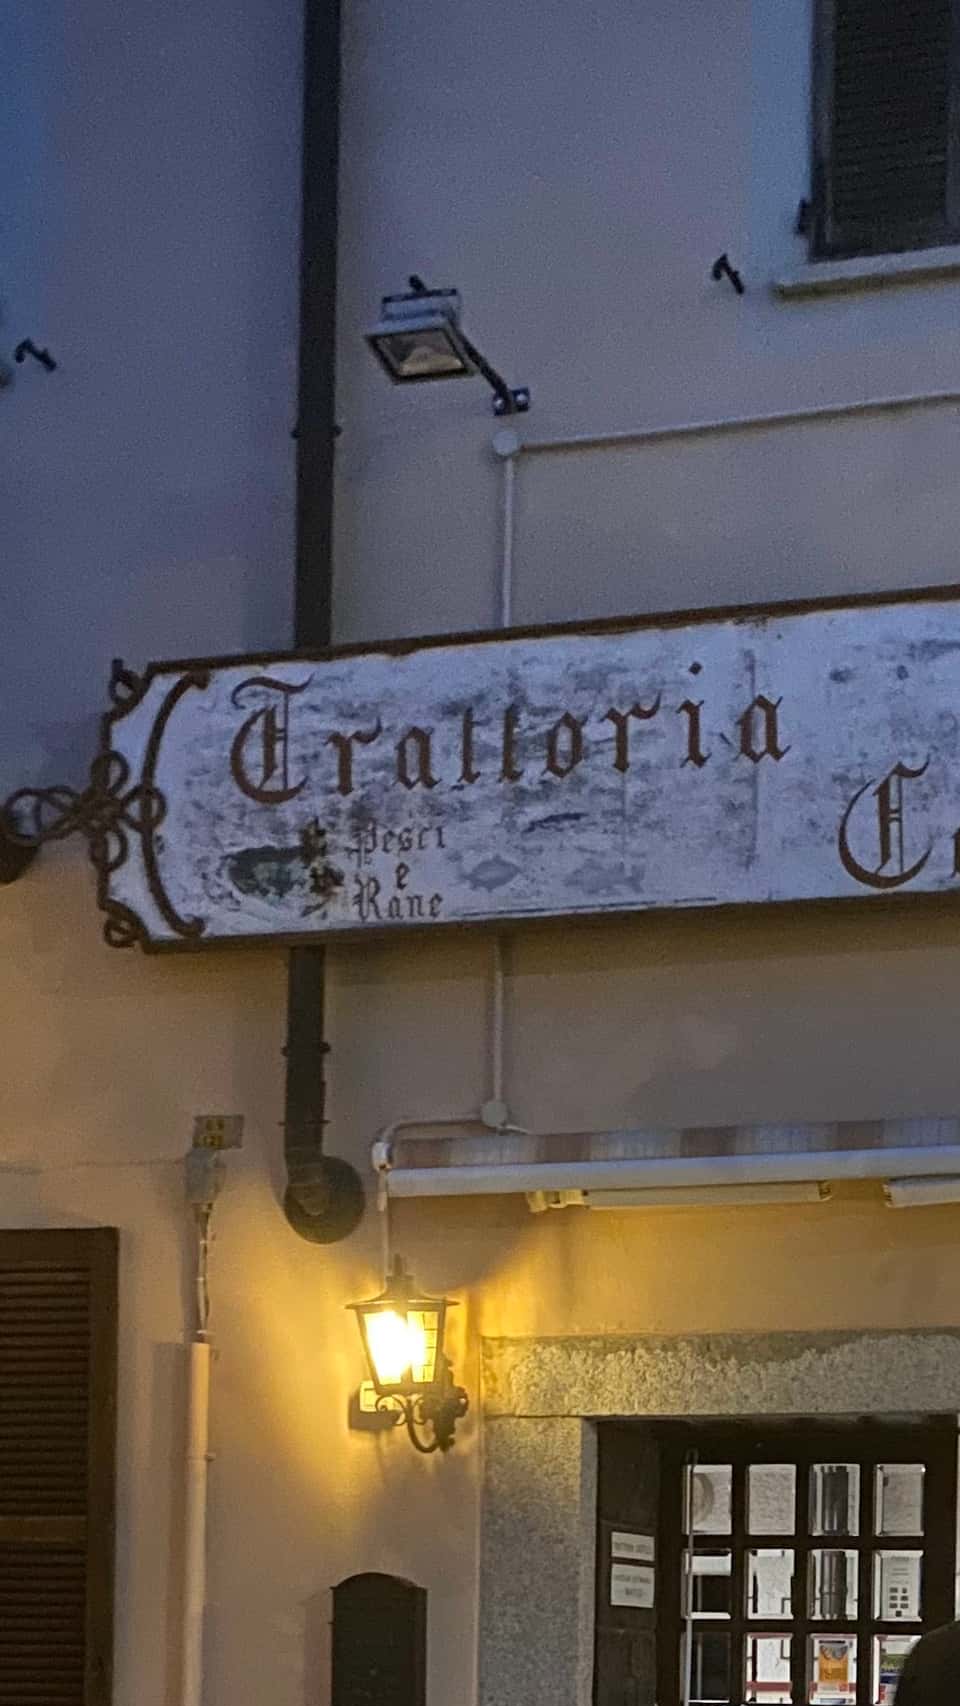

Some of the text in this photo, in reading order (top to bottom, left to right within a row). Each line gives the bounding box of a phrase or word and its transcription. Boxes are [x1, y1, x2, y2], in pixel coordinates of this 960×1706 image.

[229, 661, 792, 804] Trattoria
[344, 816, 447, 868] Pesci
[352, 872, 444, 922] Rane
[395, 861, 411, 890] e
